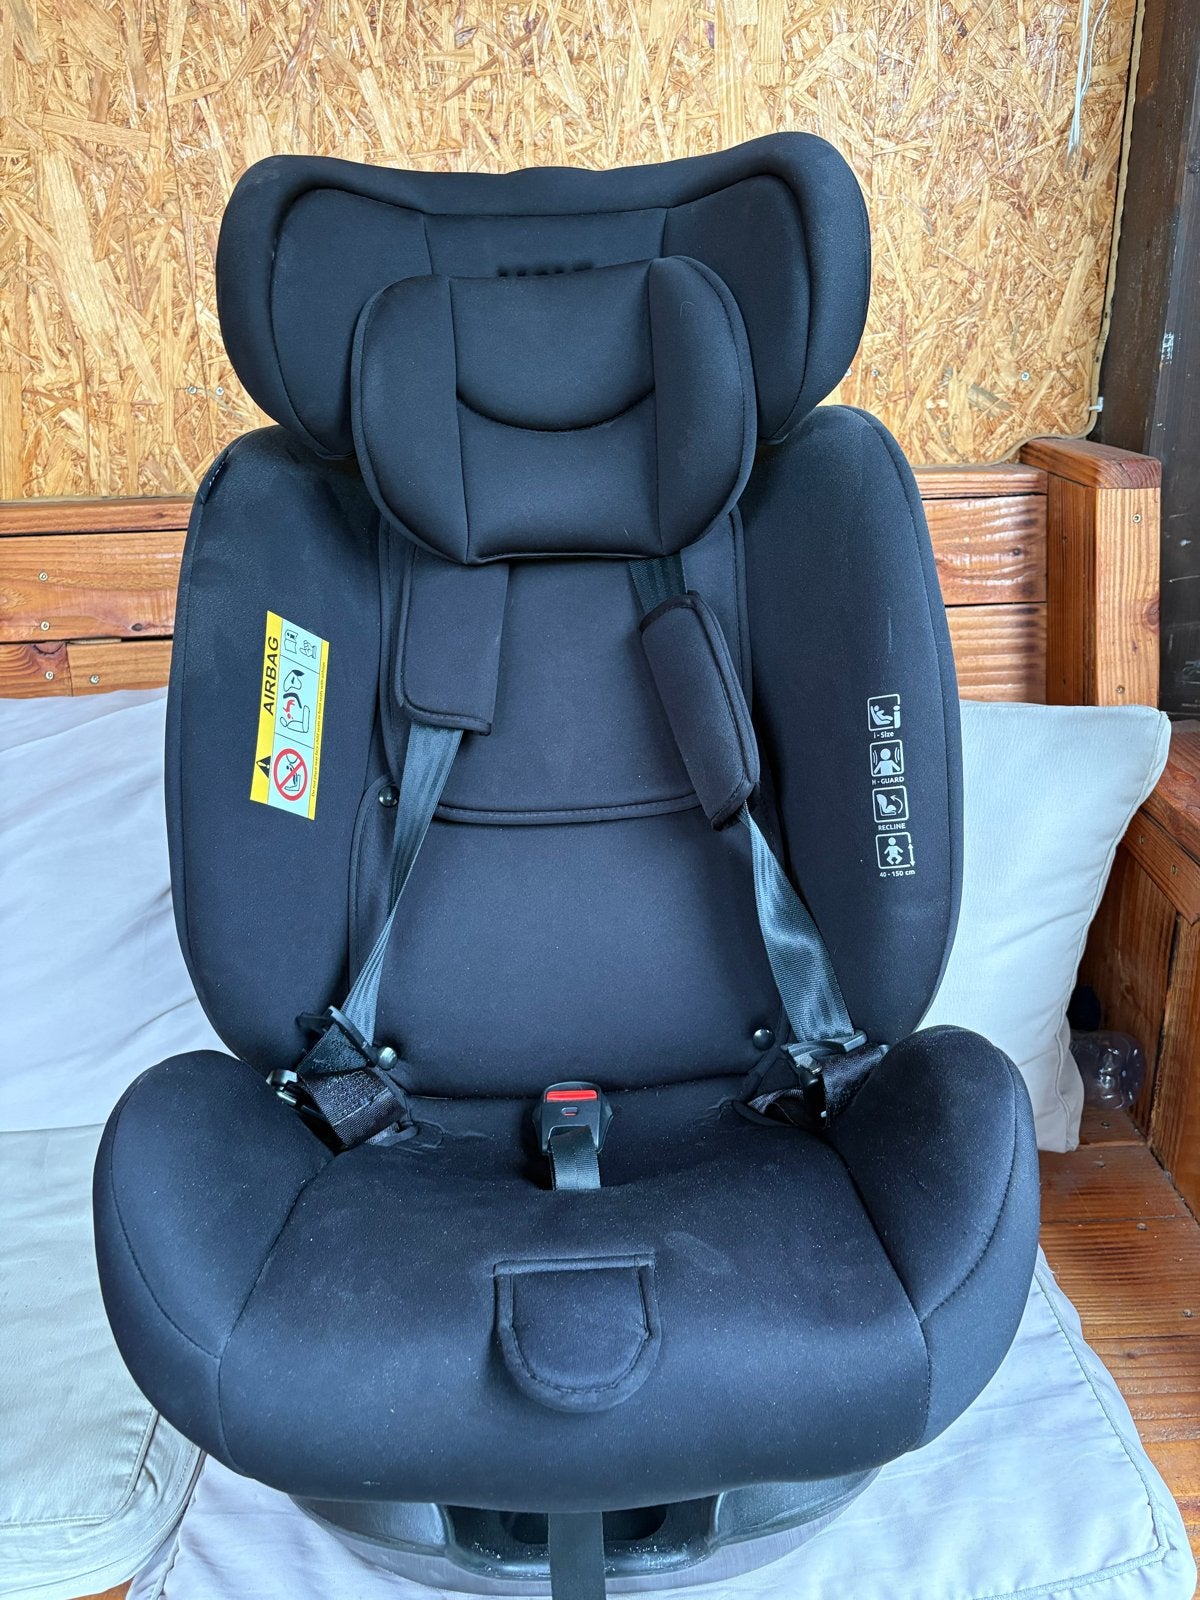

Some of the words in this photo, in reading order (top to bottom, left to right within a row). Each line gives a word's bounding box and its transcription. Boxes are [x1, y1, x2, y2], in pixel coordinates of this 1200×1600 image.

[263, 636, 279, 716] AIRBAG
[880, 776, 905, 785] GUARD
[877, 822, 906, 831] RECLINE
